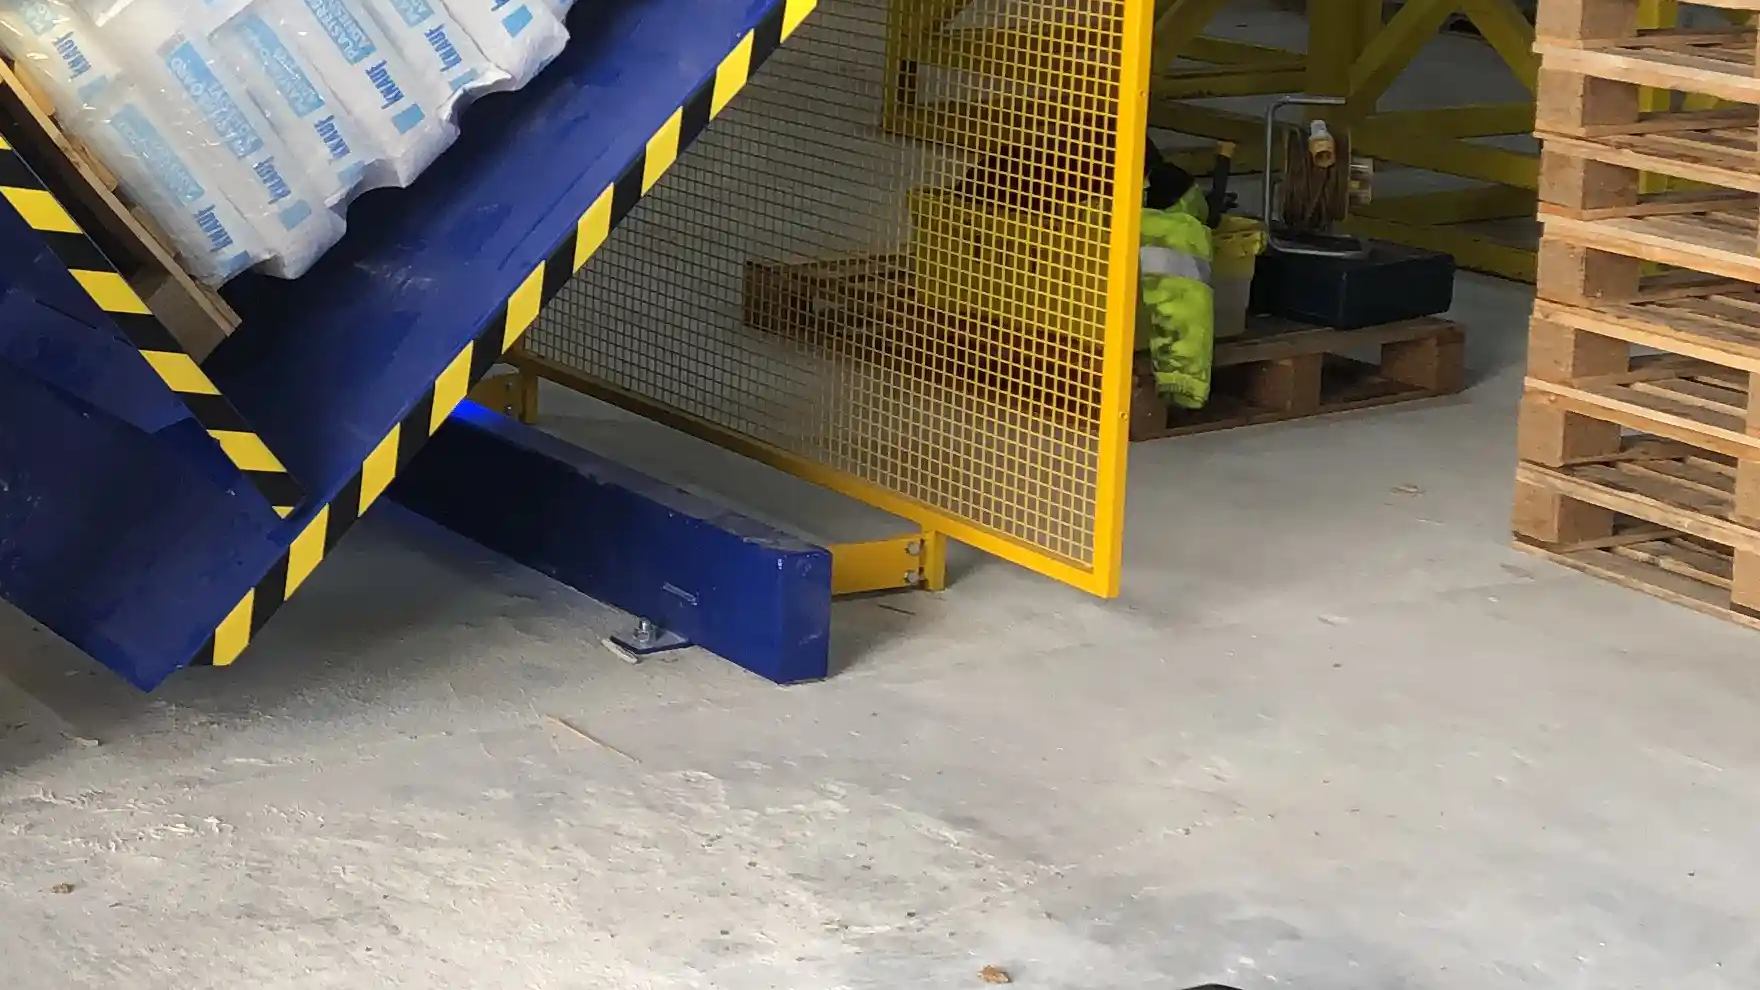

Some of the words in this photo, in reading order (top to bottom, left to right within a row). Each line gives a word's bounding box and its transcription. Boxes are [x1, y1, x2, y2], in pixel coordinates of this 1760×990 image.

[423, 23, 462, 72] KNAUF
[364, 60, 404, 108] KNAUF
[313, 114, 350, 163] KNAUF
